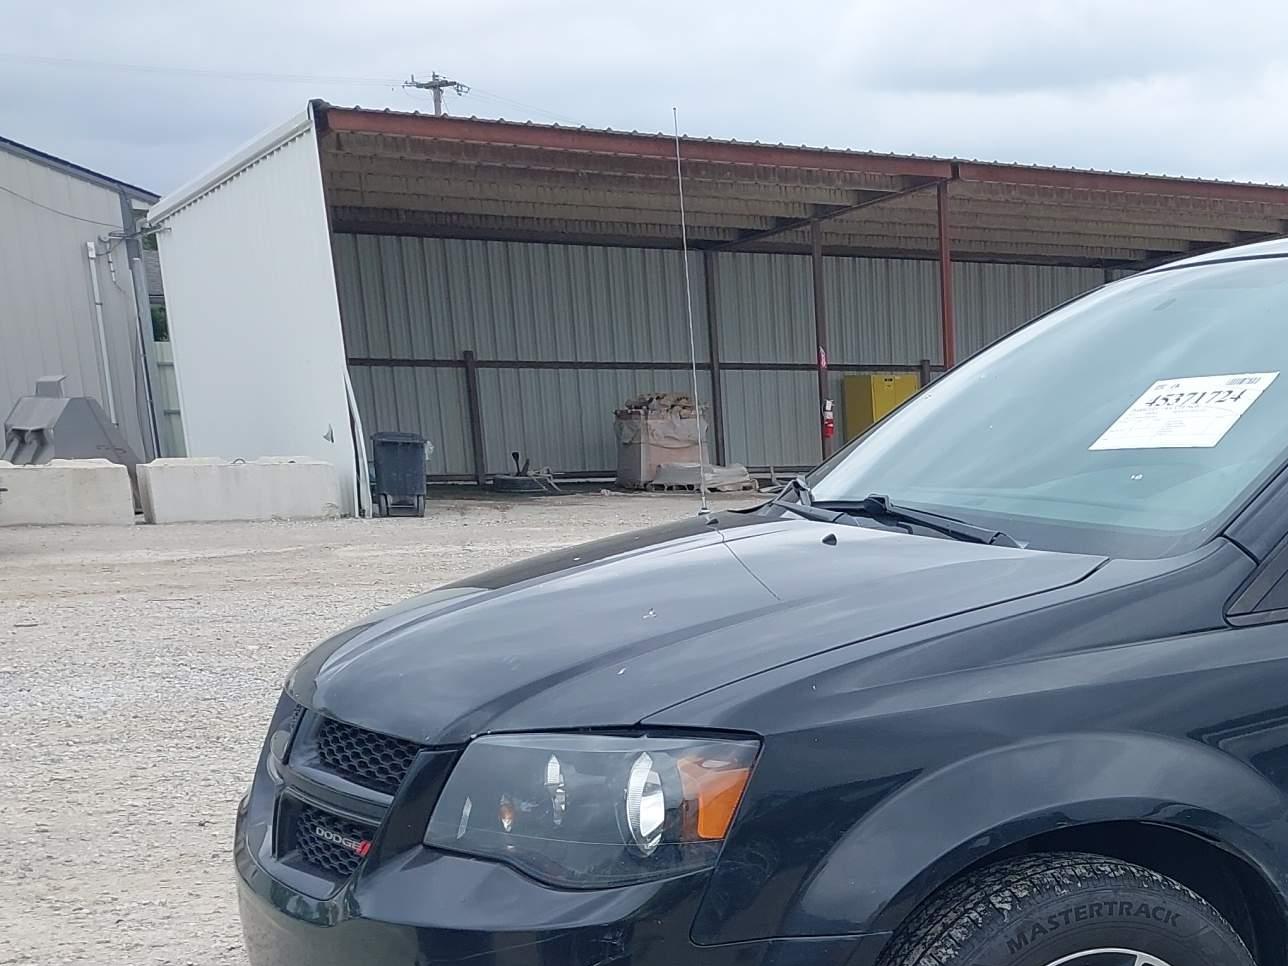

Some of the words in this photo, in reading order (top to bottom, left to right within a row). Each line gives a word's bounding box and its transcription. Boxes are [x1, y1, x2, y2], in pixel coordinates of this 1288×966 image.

[1145, 389, 1247, 406] 45371724
[316, 827, 361, 851] DODGE
[1005, 901, 1182, 954] MASTERTRACK
